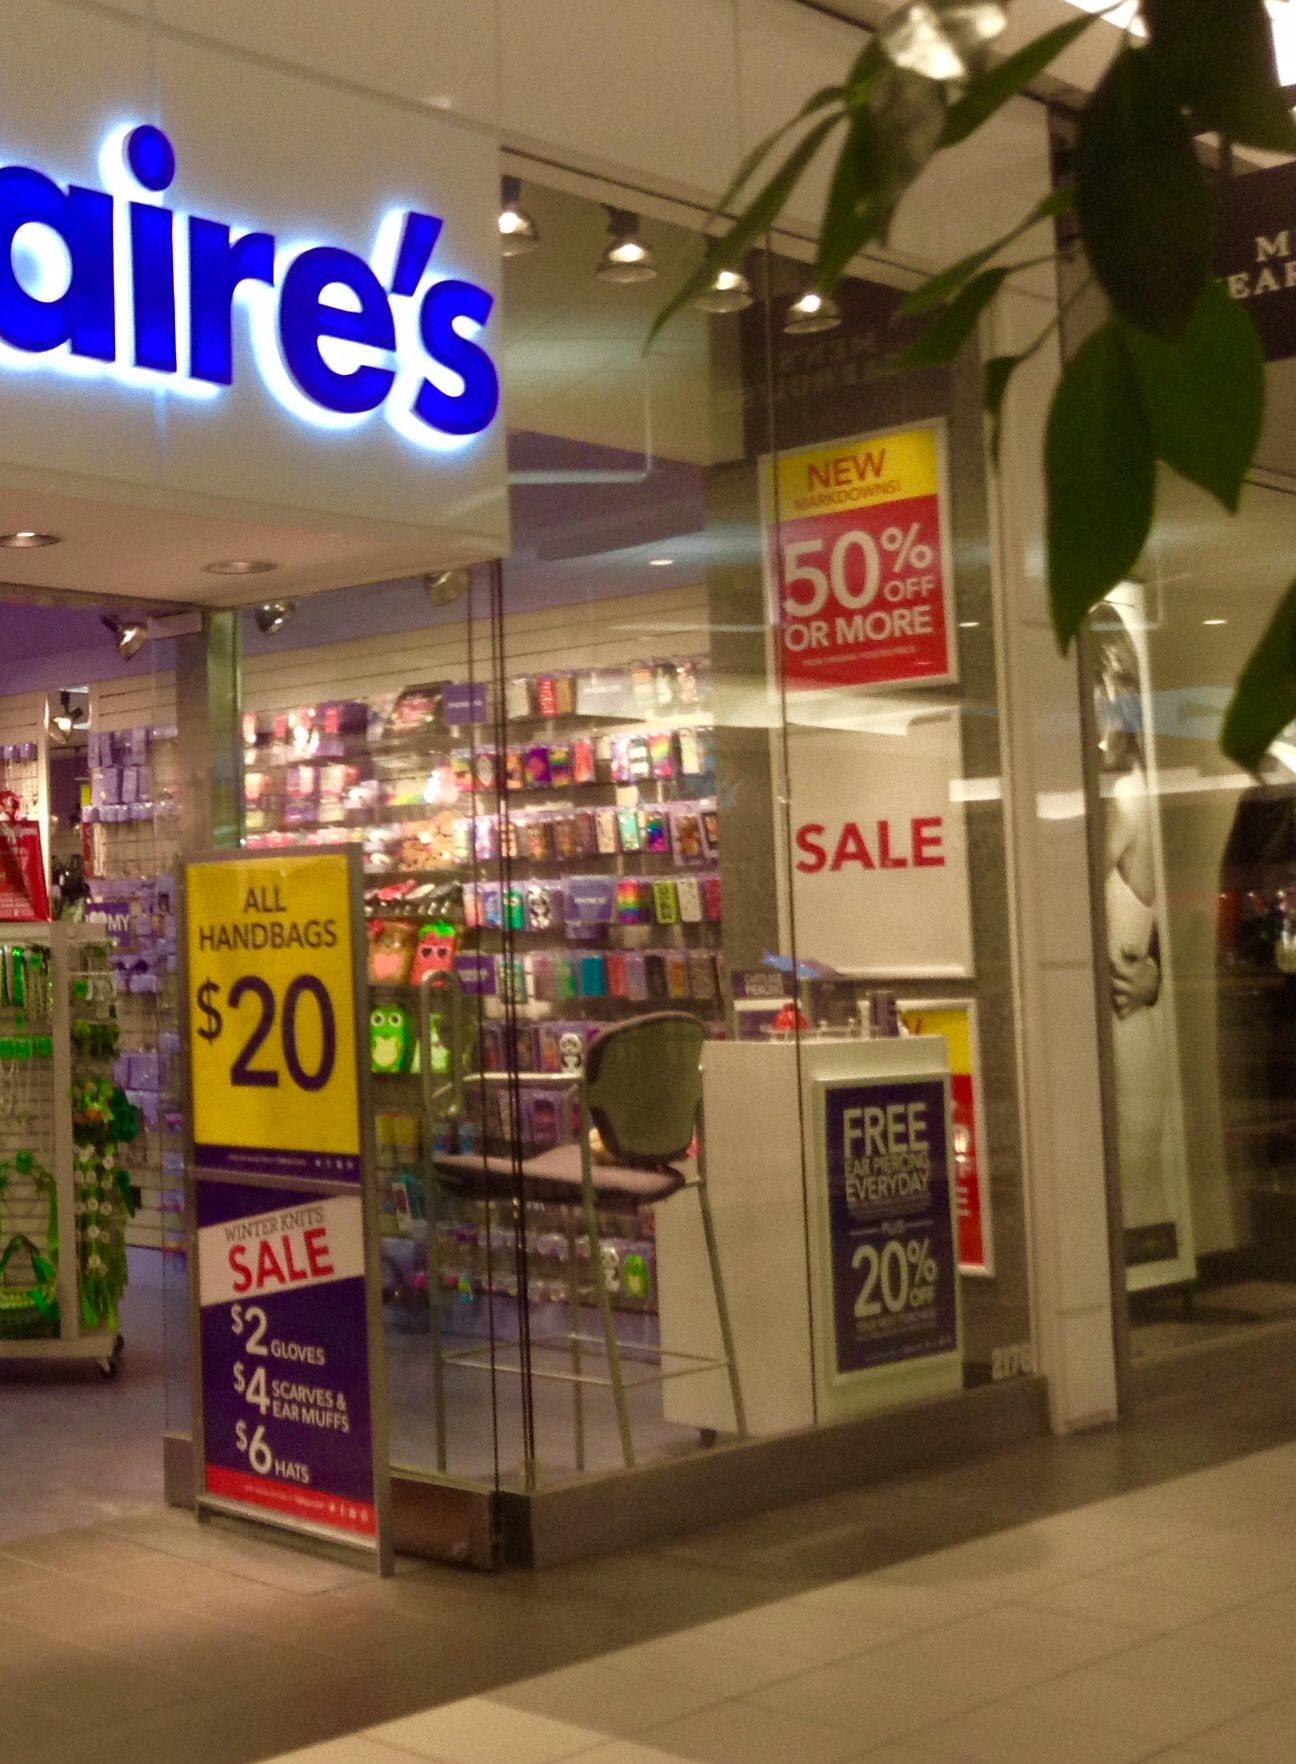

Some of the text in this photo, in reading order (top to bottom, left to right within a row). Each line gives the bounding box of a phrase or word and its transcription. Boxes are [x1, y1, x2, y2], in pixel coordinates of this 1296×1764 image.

[807, 448, 887, 491] NEW
[783, 521, 934, 618] 50%
[883, 576, 936, 603] OFF
[784, 604, 934, 651] OR MORE
[795, 815, 946, 874] SALE
[243, 886, 287, 913] ALL
[199, 919, 338, 952] HANDBAGS
[196, 974, 337, 1093] $20
[843, 1102, 929, 1158] FREE
[846, 1171, 930, 1203] EVERYDAY
[224, 1205, 324, 1243] WINTER KNITS
[228, 1226, 334, 1293] SALE
[851, 1237, 938, 1317] 20%
[230, 1303, 326, 1365] $2 GLOVES
[232, 1361, 348, 1416] $4 SCARVES &
[272, 1401, 351, 1434] EAR MUFFS
[235, 1418, 311, 1484] $6 HATS
